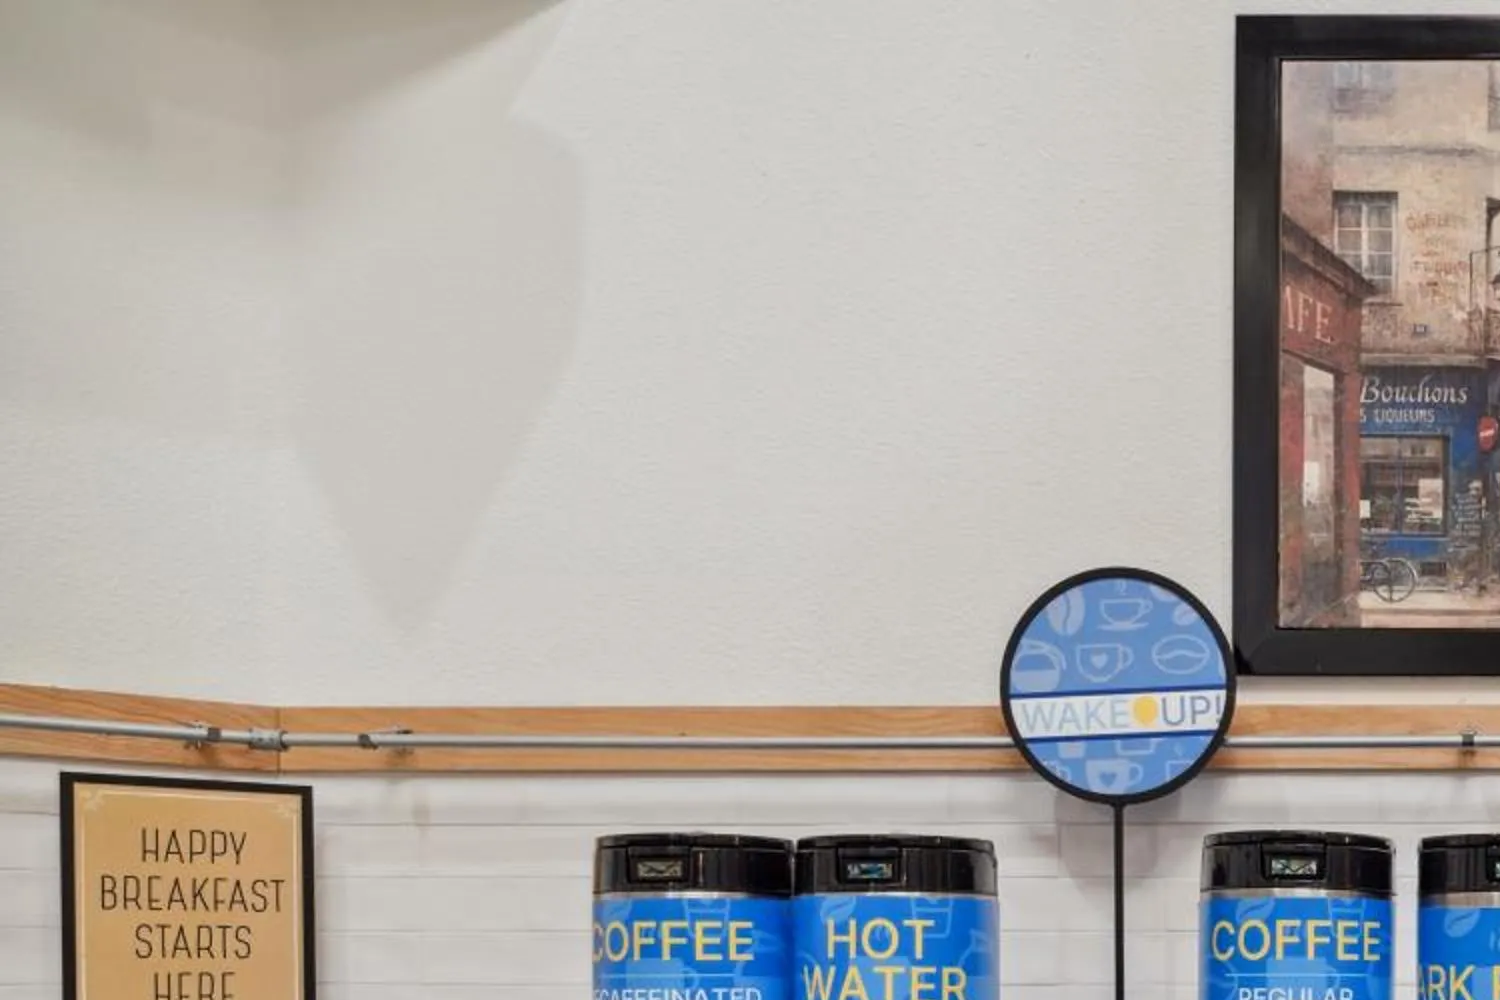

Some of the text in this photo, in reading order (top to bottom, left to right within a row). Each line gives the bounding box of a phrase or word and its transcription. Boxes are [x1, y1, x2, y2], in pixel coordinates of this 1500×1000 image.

[1360, 374, 1468, 404] Bouchons
[1022, 695, 1221, 733] WAKE UP!
[141, 827, 247, 865] HAPPY
[100, 874, 285, 913] BREAKFAST
[135, 923, 252, 960] STARTS
[593, 919, 754, 962] COFFEE
[826, 917, 936, 960] HOT
[1212, 918, 1382, 962] COFFEE
